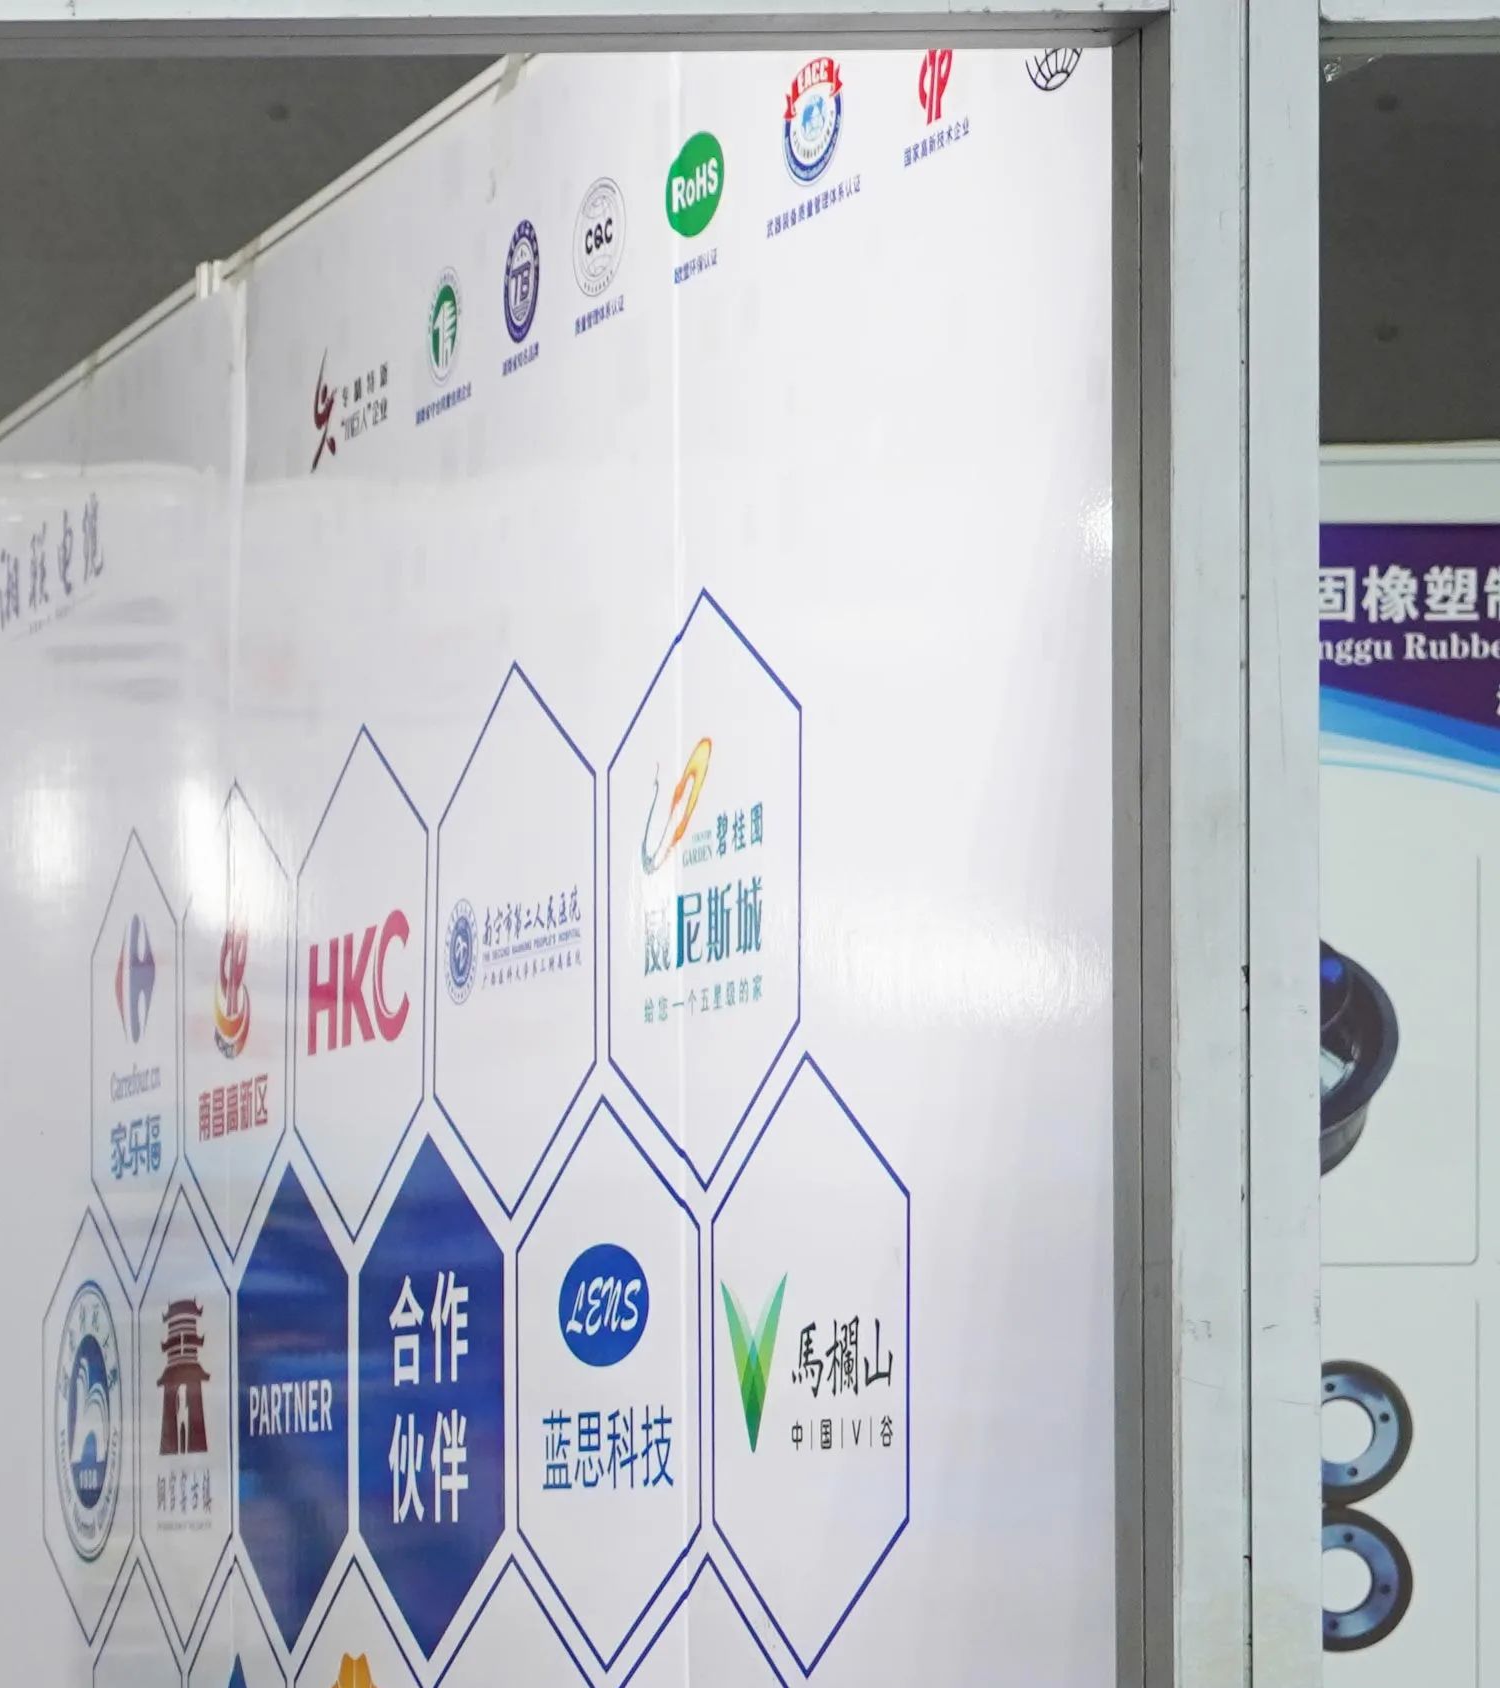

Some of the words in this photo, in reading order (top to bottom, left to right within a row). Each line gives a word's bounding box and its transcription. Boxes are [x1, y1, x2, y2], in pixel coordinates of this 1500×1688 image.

[904, 117, 971, 167] 国家高新技术企业
[672, 158, 718, 213] RoHS
[766, 174, 862, 238] 武器装备质量管理体系认证
[585, 217, 613, 255] CQC
[682, 844, 712, 868] GARDEN
[715, 802, 765, 856] 碧桂园
[482, 884, 581, 947] 南宁市第二人民医院
[644, 876, 763, 977] 威尼斯城
[307, 908, 410, 1057] HKC
[644, 975, 763, 1025] 给您一个五星级的家
[199, 1073, 268, 1144] 南昌高新区
[110, 1114, 161, 1180] 家乐福
[390, 1270, 469, 1389] 合作
[566, 1278, 643, 1336] LENS
[791, 1315, 894, 1399] 馬欄山
[249, 1376, 333, 1438] PARTNER
[388, 1406, 469, 1527] 伙伴
[542, 1404, 673, 1494] 蓝思科技
